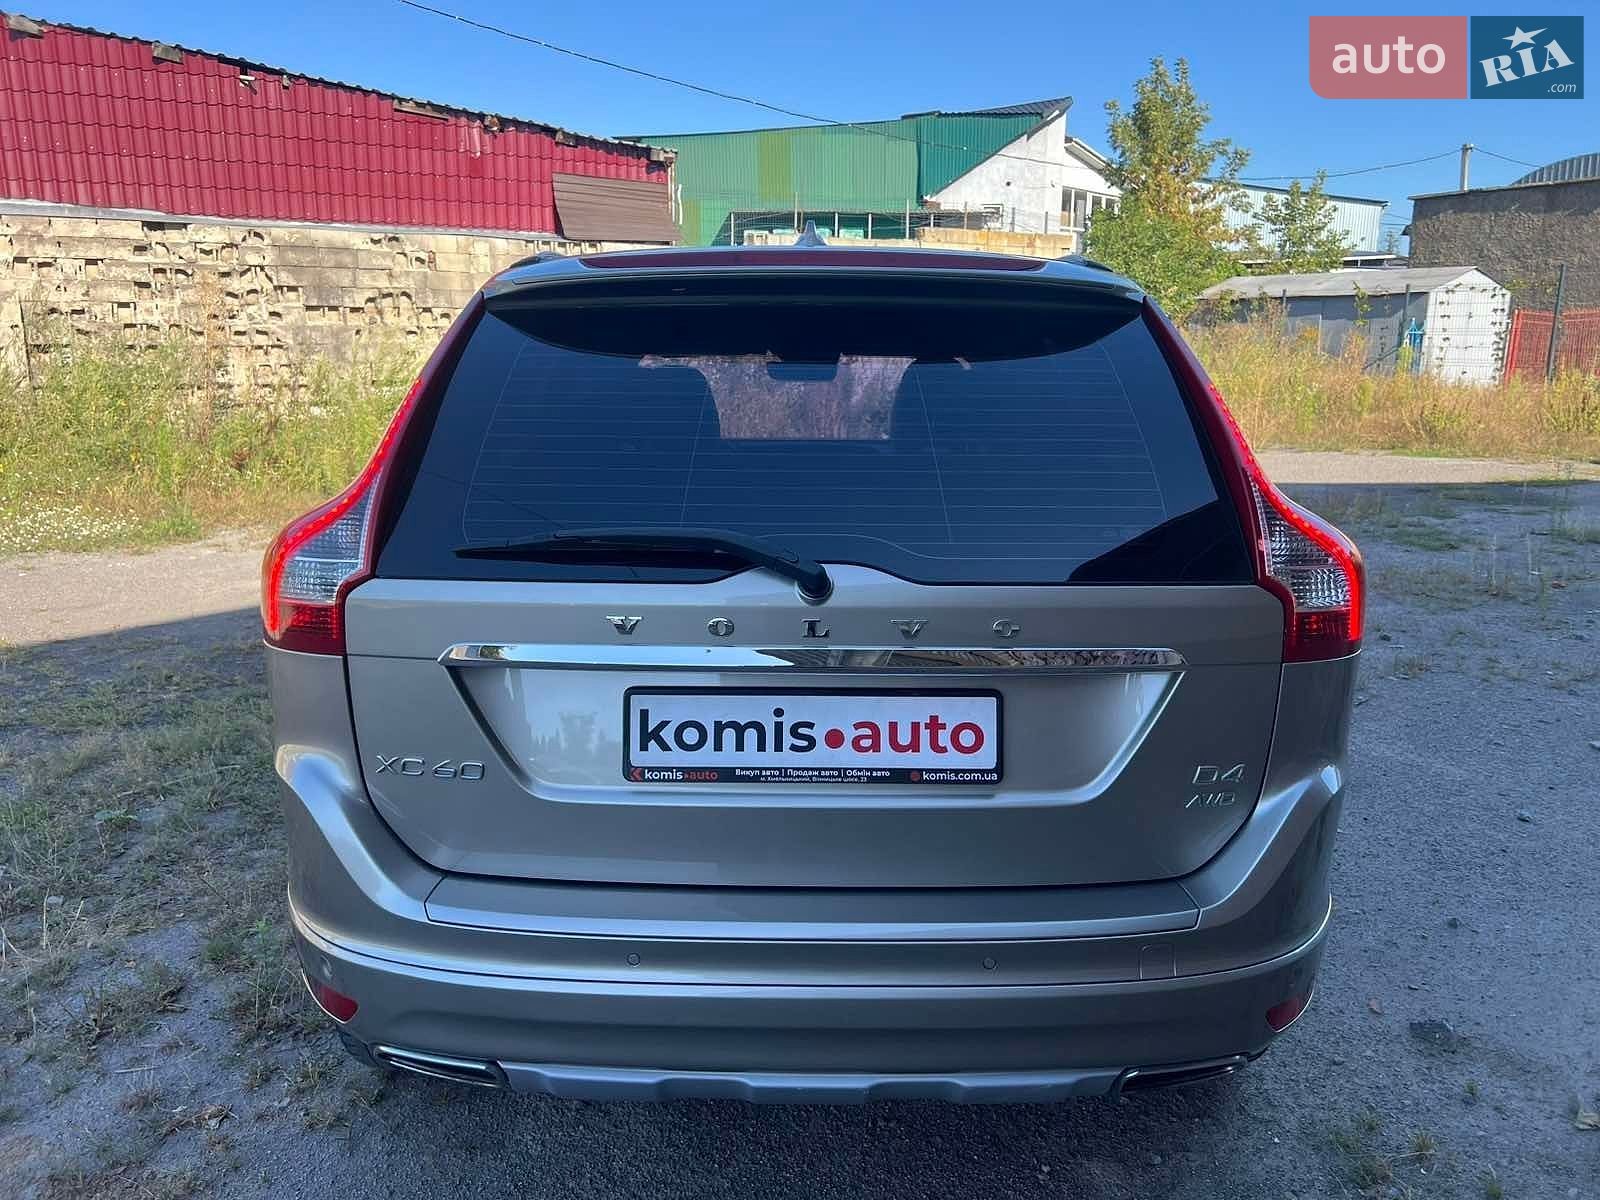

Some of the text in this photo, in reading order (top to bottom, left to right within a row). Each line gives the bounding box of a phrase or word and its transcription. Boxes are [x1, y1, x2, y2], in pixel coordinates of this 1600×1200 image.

[606, 615, 1021, 639] VOLVO
[735, 768, 760, 777] Викуп
[787, 769, 819, 777] Продаж
[820, 769, 839, 777] авто
[922, 771, 998, 780] komis.com.ua
[1192, 763, 1246, 784] D4
